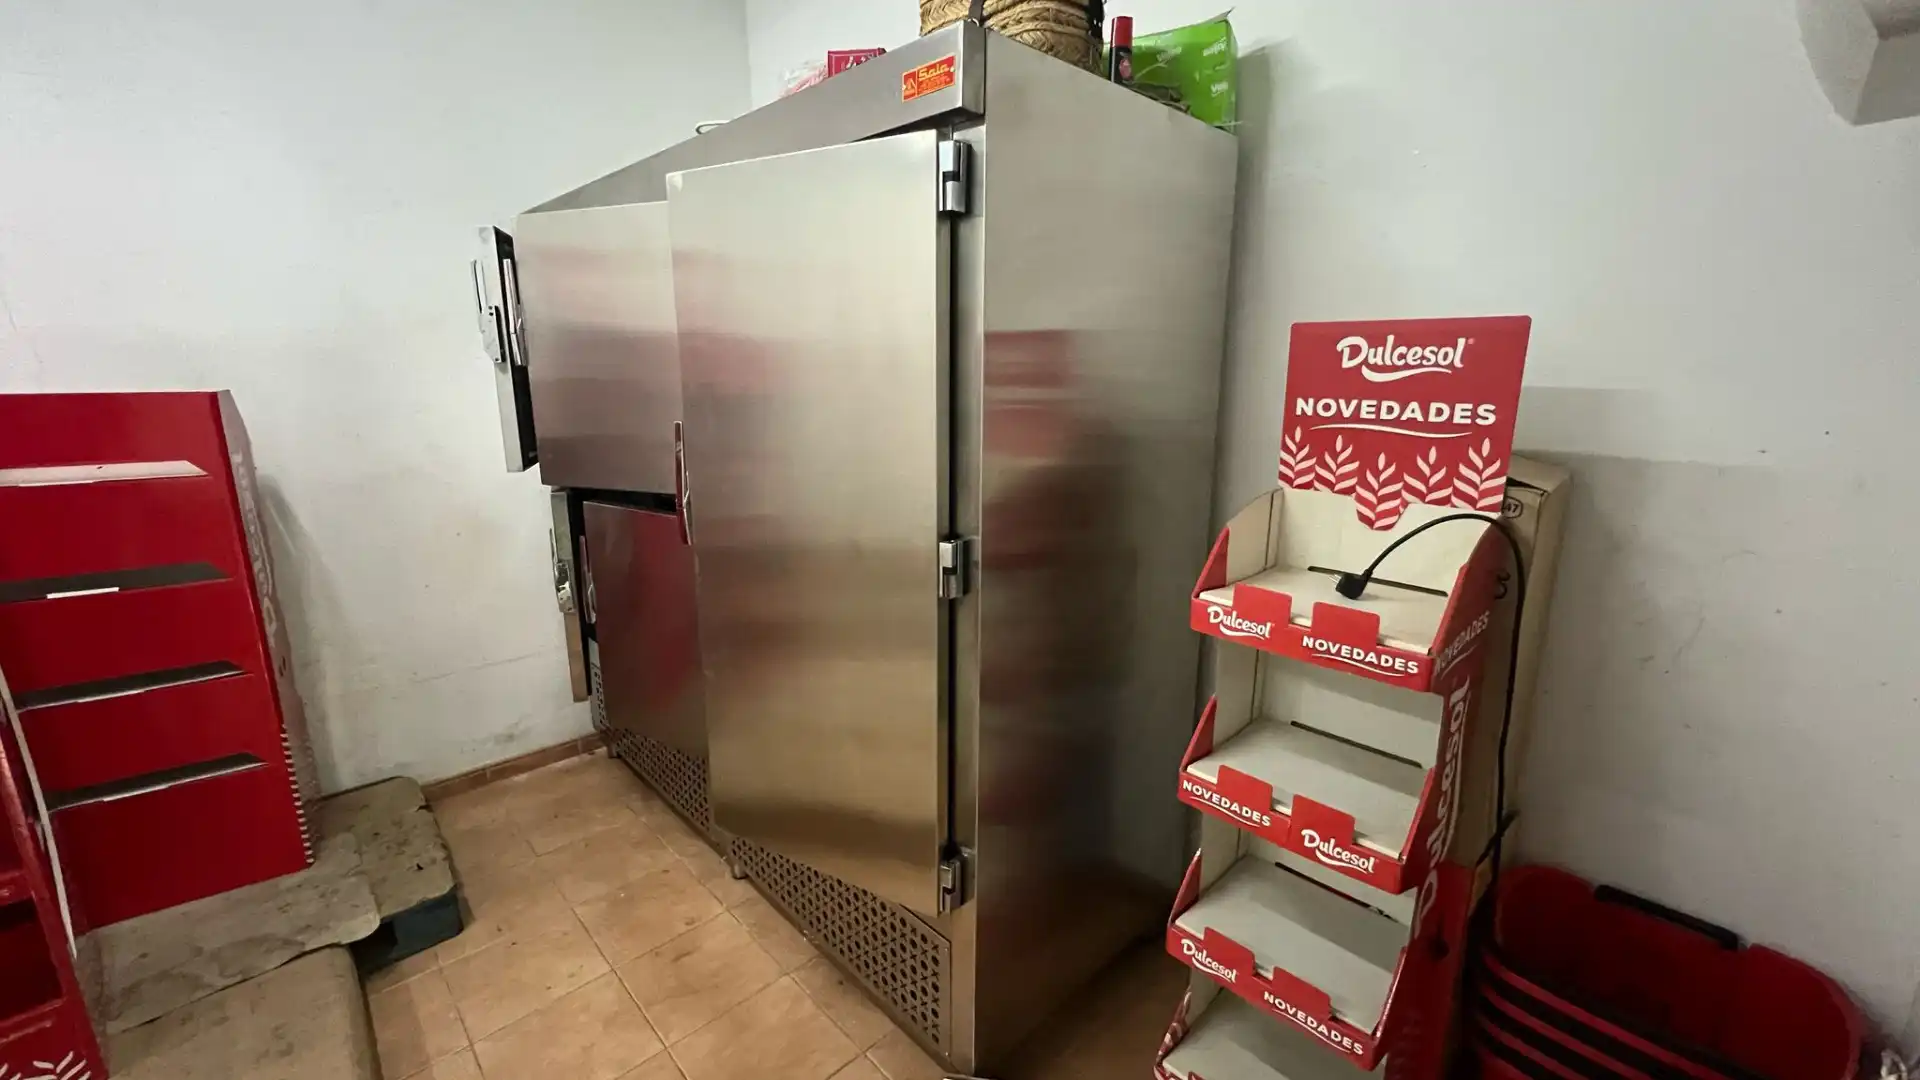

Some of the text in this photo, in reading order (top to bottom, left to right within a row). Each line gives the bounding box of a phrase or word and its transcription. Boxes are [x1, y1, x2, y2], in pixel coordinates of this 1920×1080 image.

[1336, 335, 1466, 369] Dulcesol
[1295, 397, 1497, 426] NOVEDADES
[1207, 604, 1420, 674] Dulcesol NOVEDADES
[1182, 779, 1375, 873] NOVEDADES Dulcesol
[1181, 938, 1363, 1055] Dulcesol NOVEDADES
